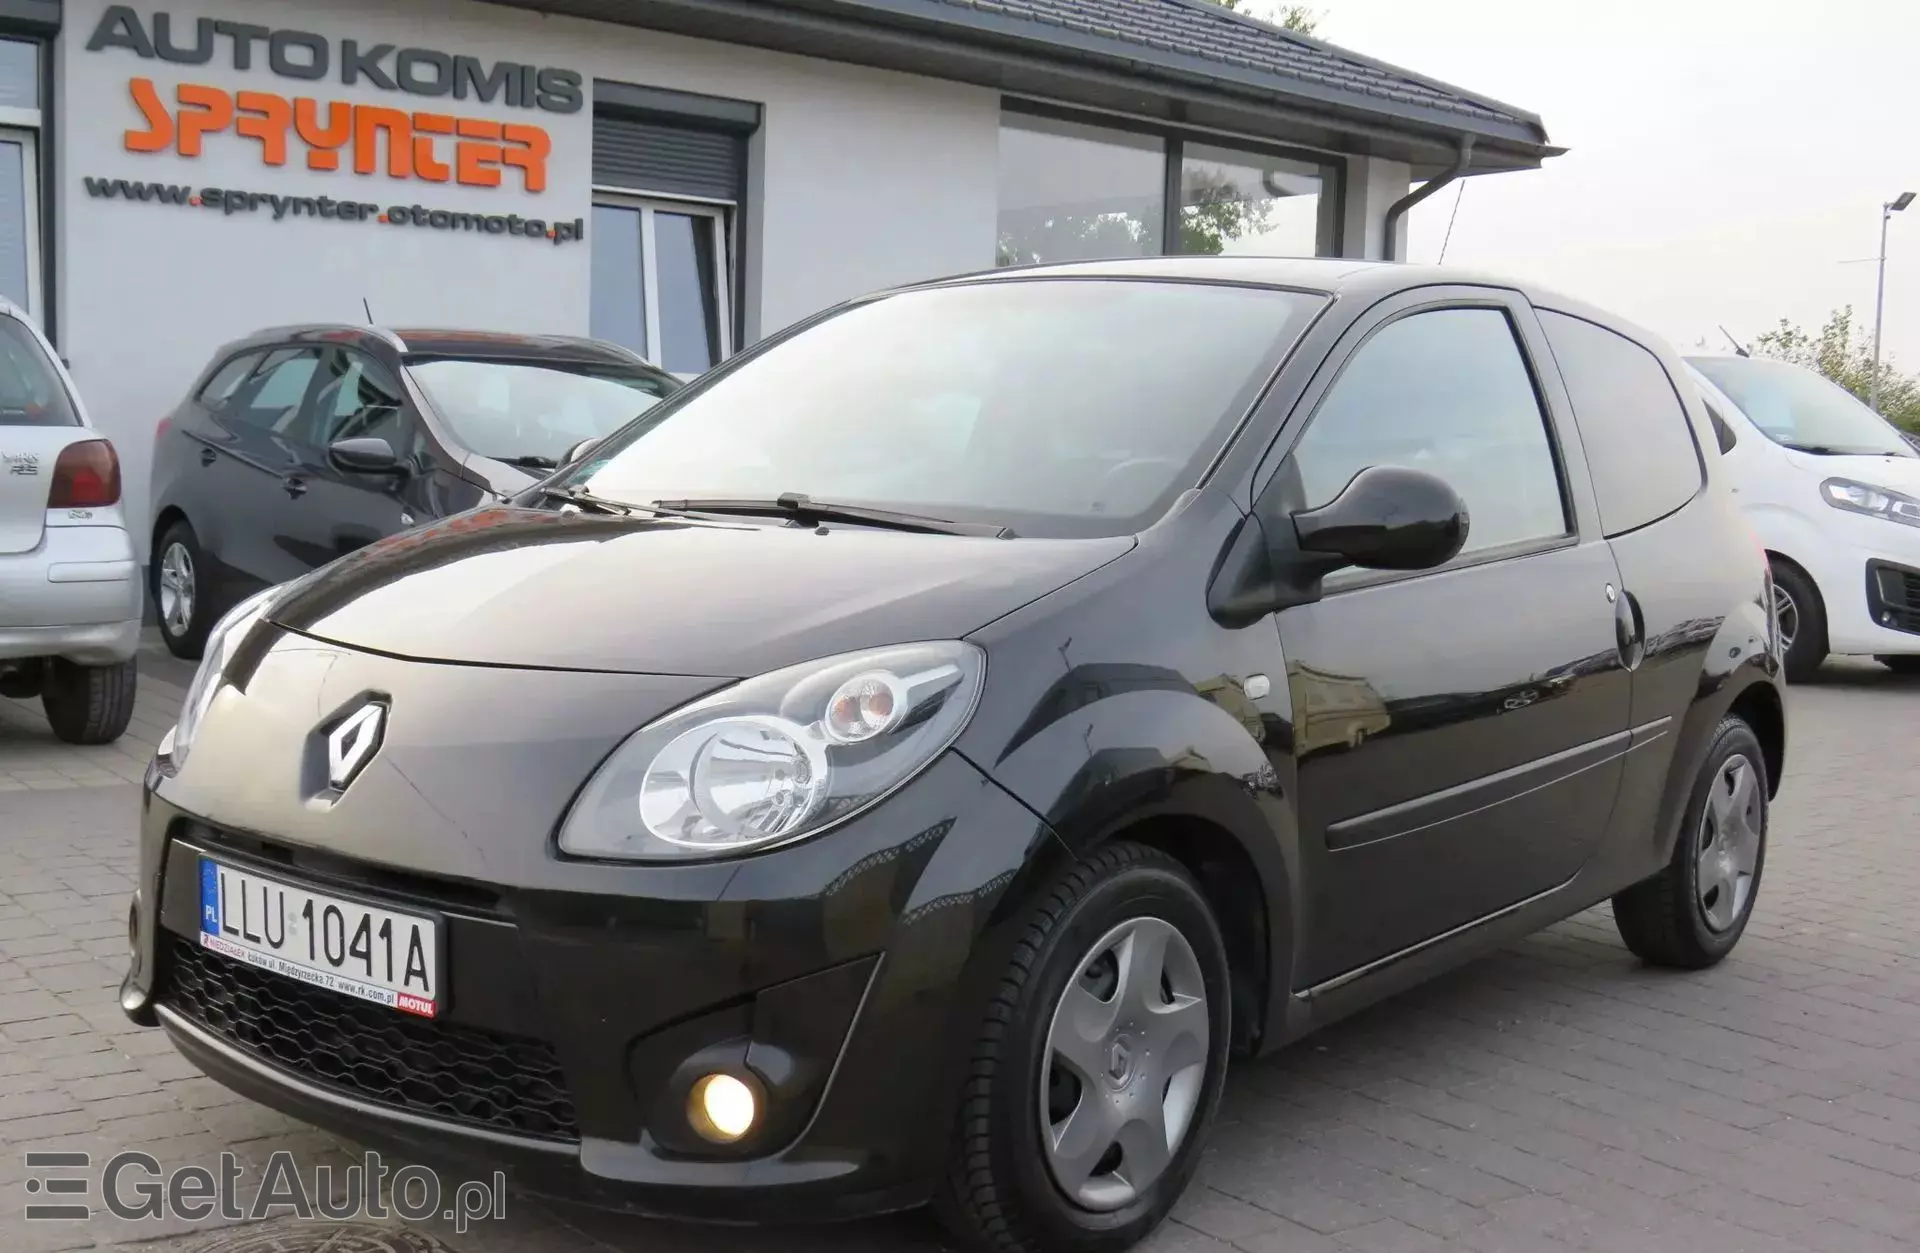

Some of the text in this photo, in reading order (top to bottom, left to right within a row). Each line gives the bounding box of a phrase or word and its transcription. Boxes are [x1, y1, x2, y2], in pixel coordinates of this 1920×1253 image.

[86, 5, 584, 114] AUTO KOMIS
[124, 77, 552, 192] SPRYNTER
[84, 176, 584, 244] www.sprynter.otomoto.pl
[205, 904, 217, 924] PL
[220, 872, 429, 992] LLU 1041A
[399, 995, 433, 1015] MOTUL
